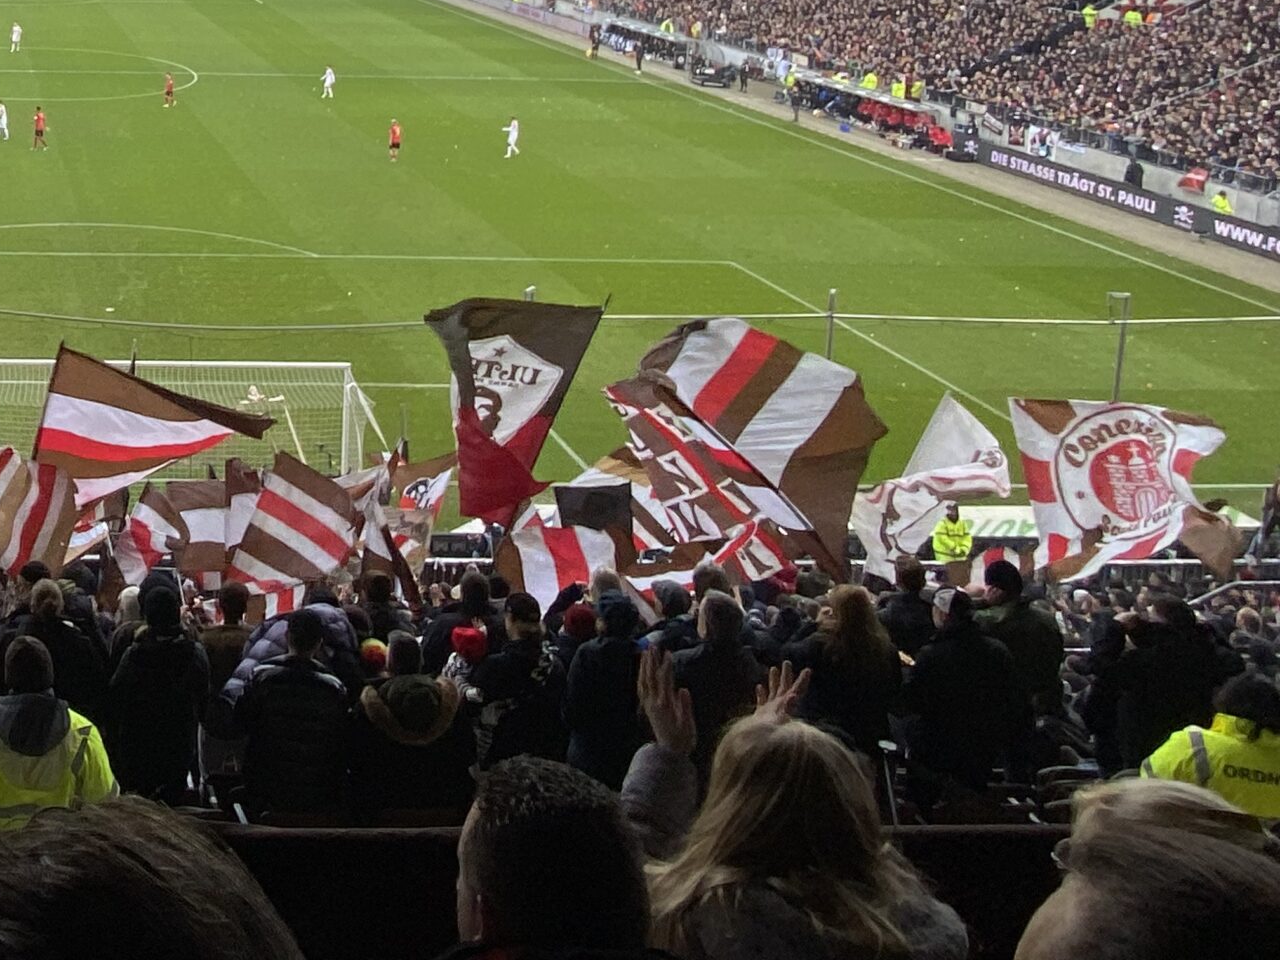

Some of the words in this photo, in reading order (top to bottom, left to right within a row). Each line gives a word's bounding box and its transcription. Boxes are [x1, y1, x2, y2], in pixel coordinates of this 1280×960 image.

[990, 150, 1008, 167] DIE
[1009, 157, 1055, 182] STRASSE
[1057, 170, 1096, 198] TRÄGT
[1097, 183, 1116, 202] ST.
[1117, 190, 1156, 214] PAULI
